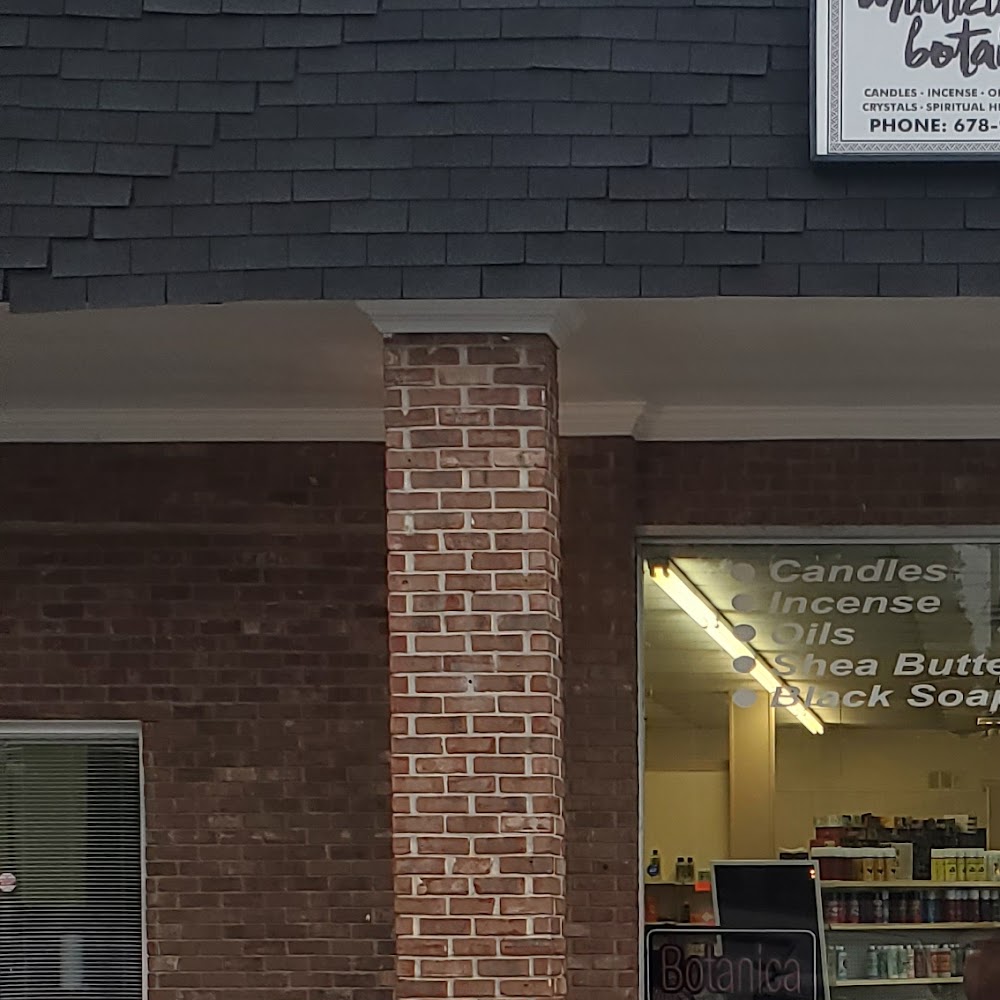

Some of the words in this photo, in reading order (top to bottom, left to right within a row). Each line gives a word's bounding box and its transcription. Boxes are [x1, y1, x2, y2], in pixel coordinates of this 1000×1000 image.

[864, 88, 918, 98] CANDLES
[927, 88, 978, 98] INCENSE
[862, 102, 918, 112] CRYSTALS
[926, 102, 985, 112] SPIRITUAL
[869, 118, 947, 133] PHONE:
[769, 558, 948, 584] Candles
[768, 591, 942, 615] Incense
[772, 621, 856, 646] Oils
[772, 653, 879, 677] Shea
[769, 684, 895, 709] Black
[661, 943, 801, 994] Botanica
